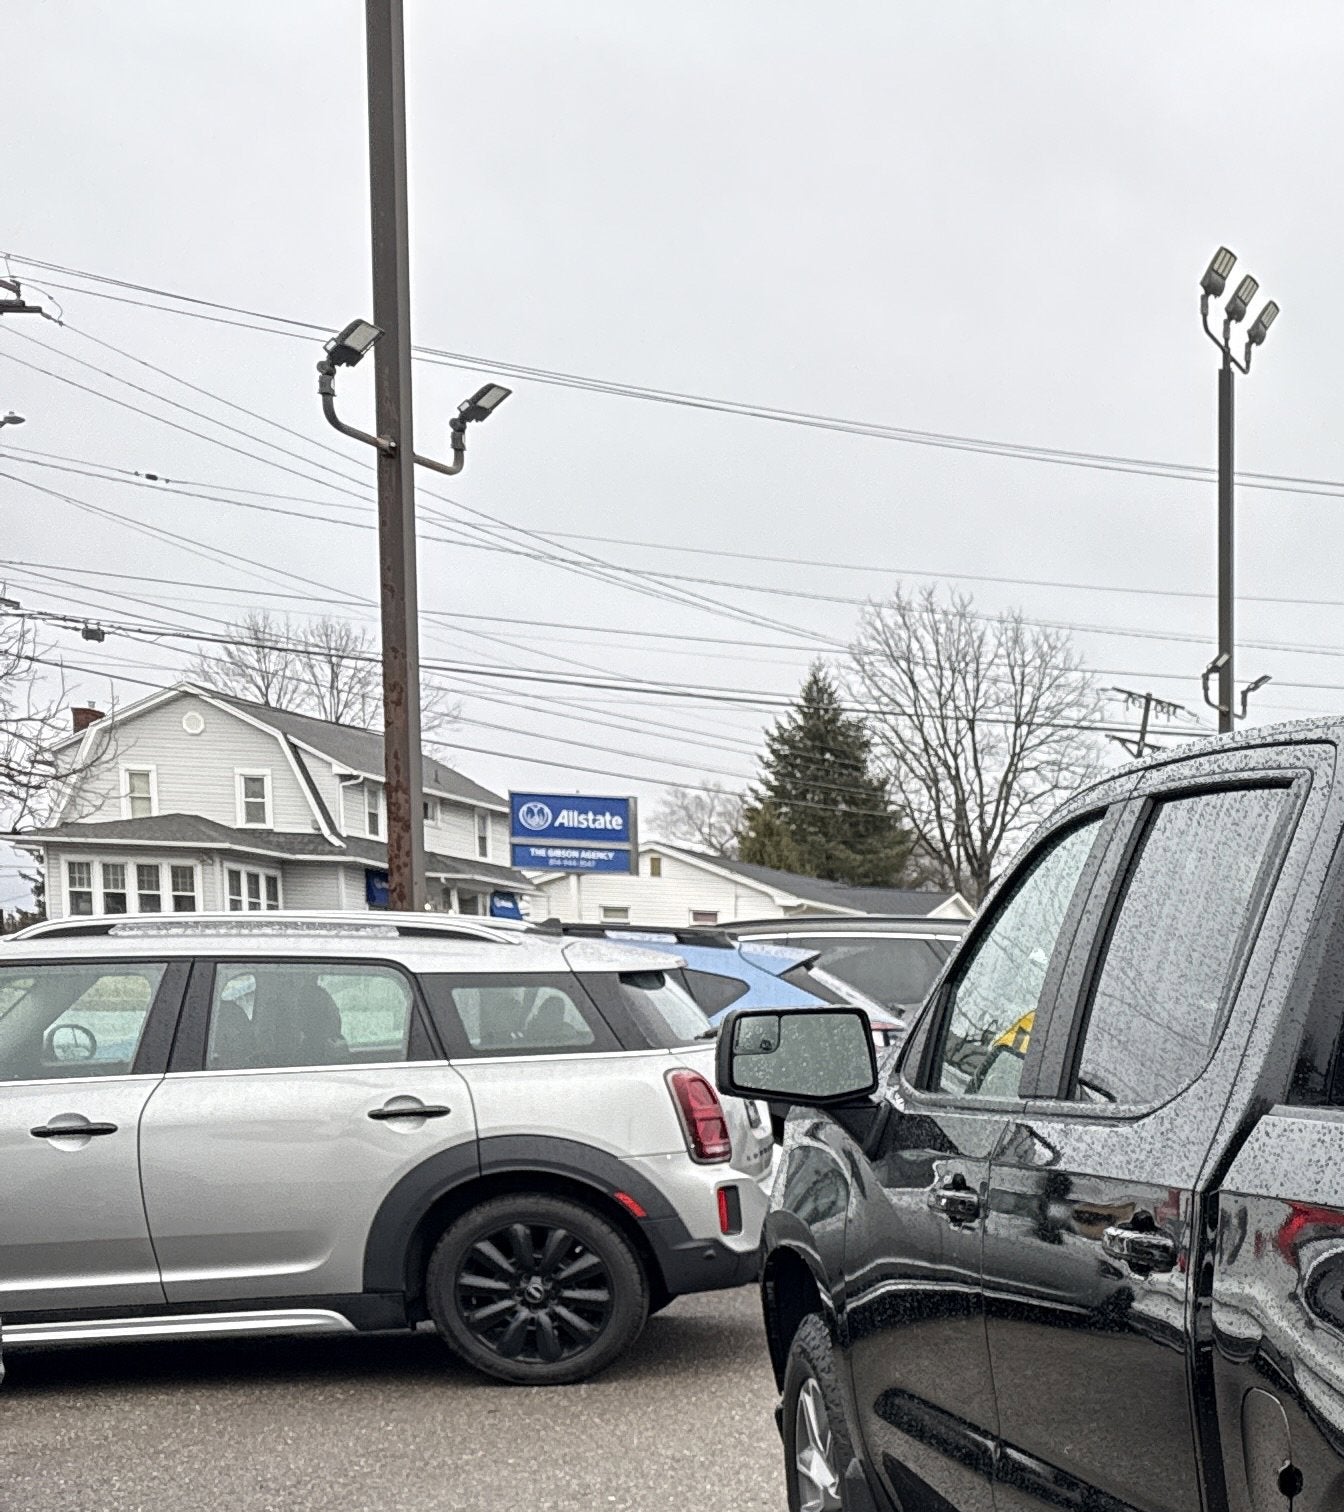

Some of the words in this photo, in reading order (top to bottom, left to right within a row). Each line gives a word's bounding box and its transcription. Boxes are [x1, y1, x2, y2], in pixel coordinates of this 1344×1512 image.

[554, 809, 623, 831] Allstate
[530, 847, 546, 857] THE
[580, 849, 615, 861] AGENCY
